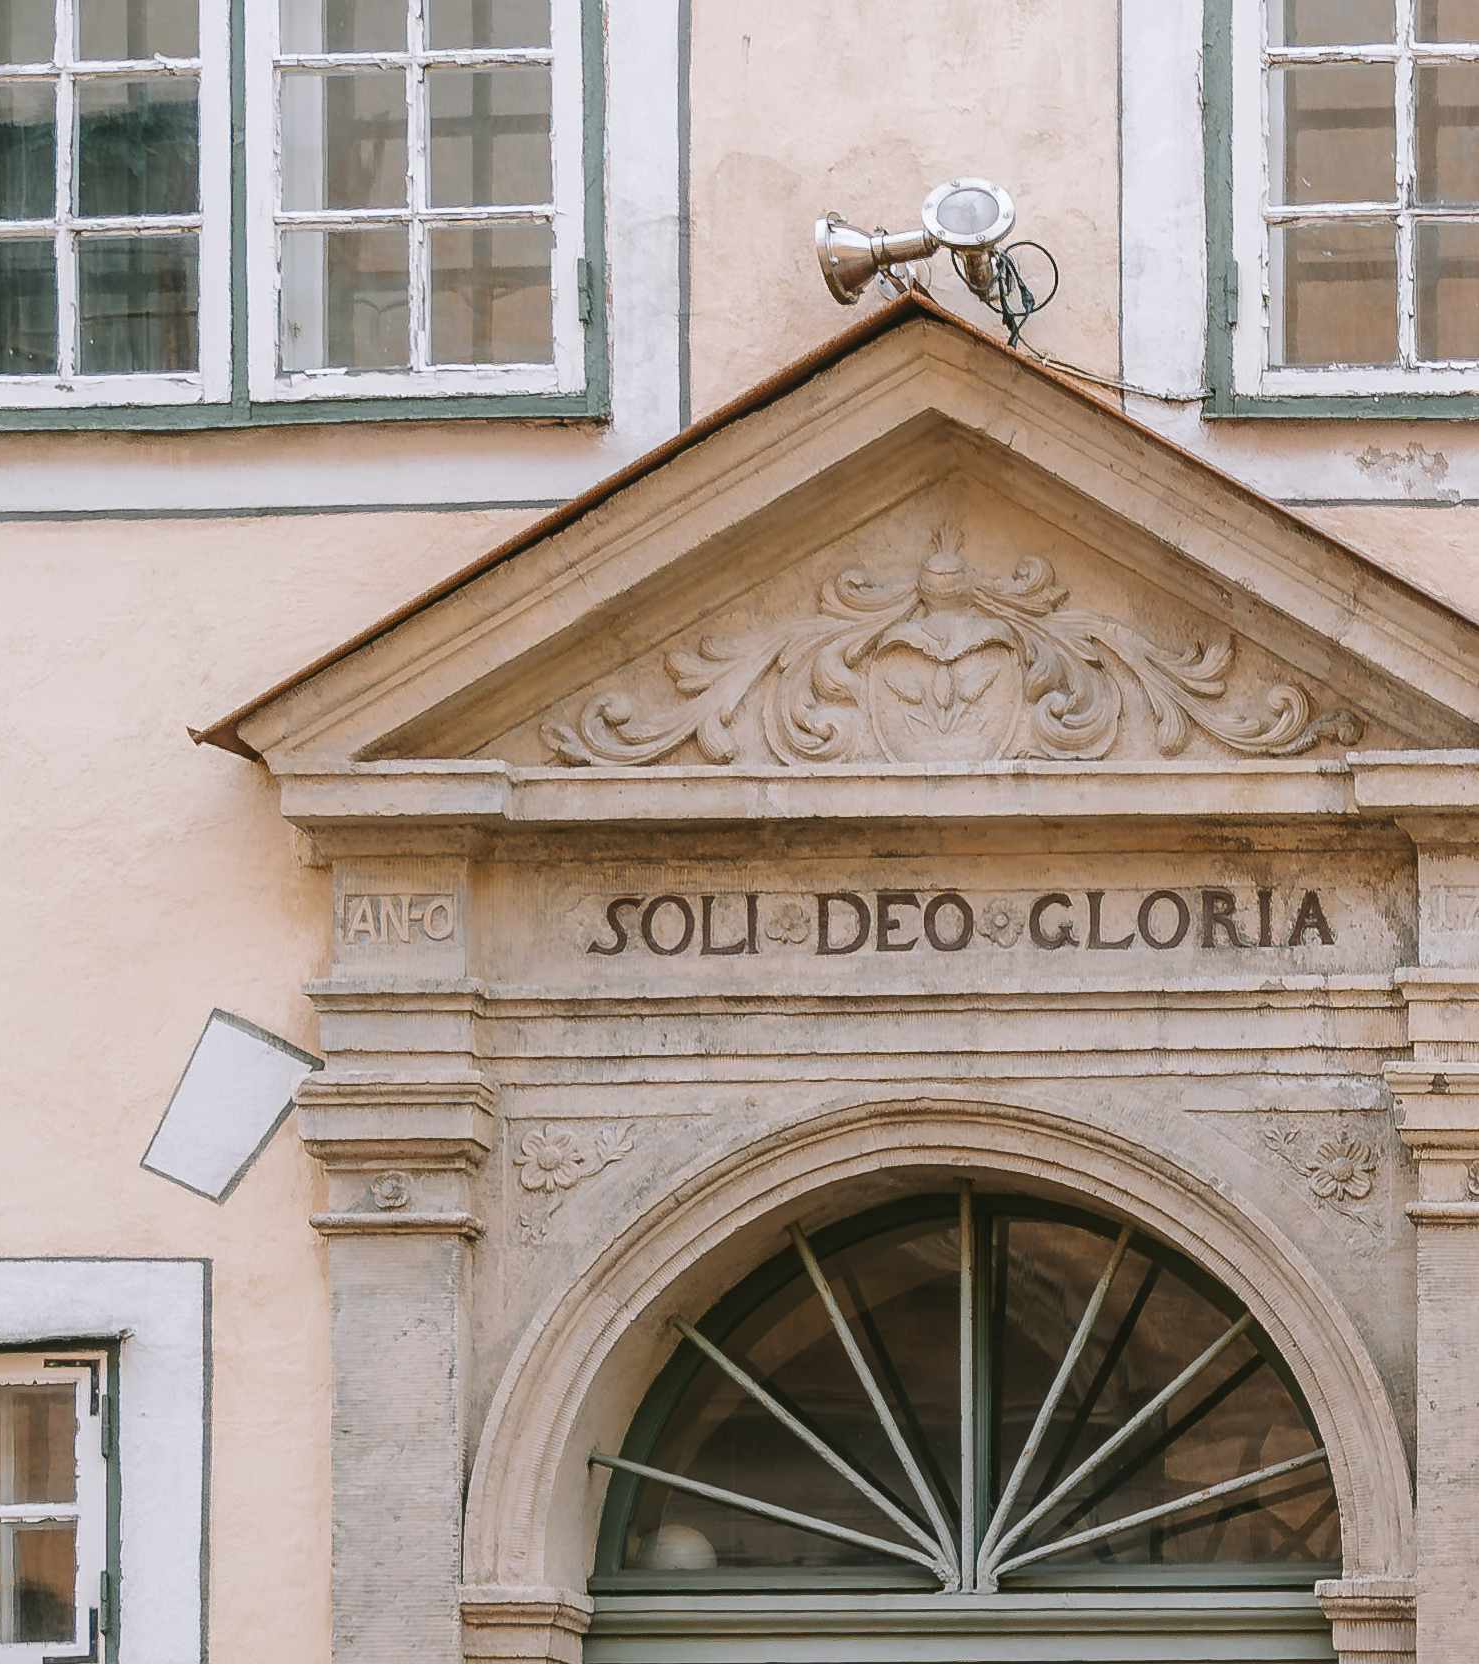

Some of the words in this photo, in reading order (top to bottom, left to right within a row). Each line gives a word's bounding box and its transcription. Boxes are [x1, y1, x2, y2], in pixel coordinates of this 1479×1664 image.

[586, 892, 760, 956] SOLI
[814, 889, 976, 955] DEO
[1028, 888, 1336, 951] GLORIA
